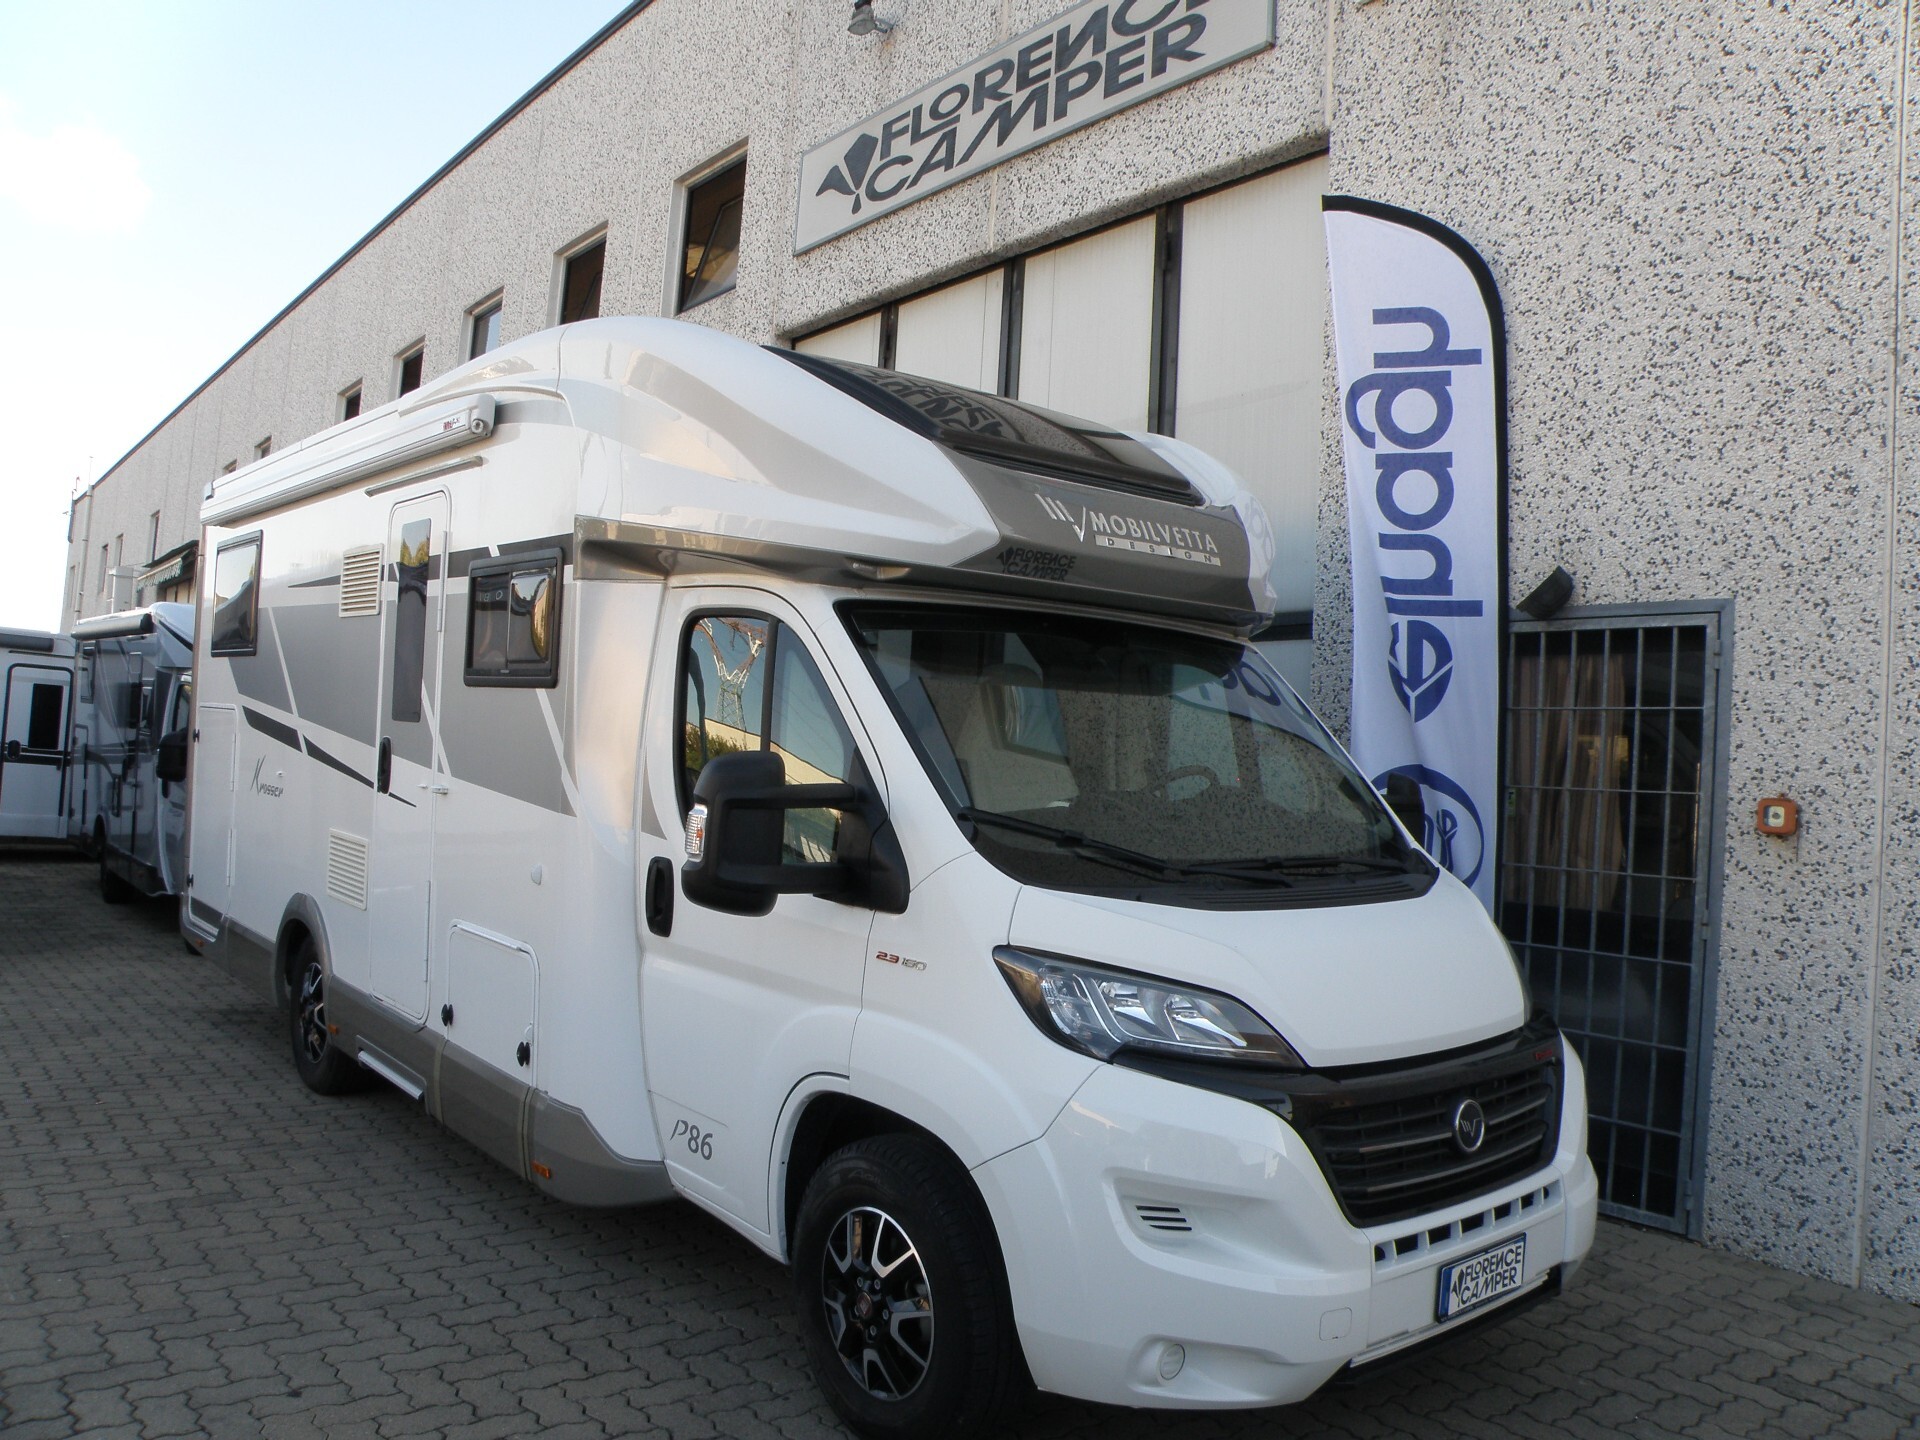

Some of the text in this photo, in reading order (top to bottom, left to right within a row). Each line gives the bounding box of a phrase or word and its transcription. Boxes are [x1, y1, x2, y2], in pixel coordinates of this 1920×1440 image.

[880, 0, 1211, 161] FLORENC
[864, 13, 1207, 202] CAMPER
[1089, 510, 1218, 553] MOBILVETTA
[1106, 537, 1212, 563] DESIGN
[1007, 561, 1068, 581] CAMPER
[1013, 547, 1077, 569] FLORENCE
[670, 1119, 713, 1160] P86
[1464, 1245, 1522, 1285] FLORENCE
[1460, 1266, 1518, 1305] CAMPER
